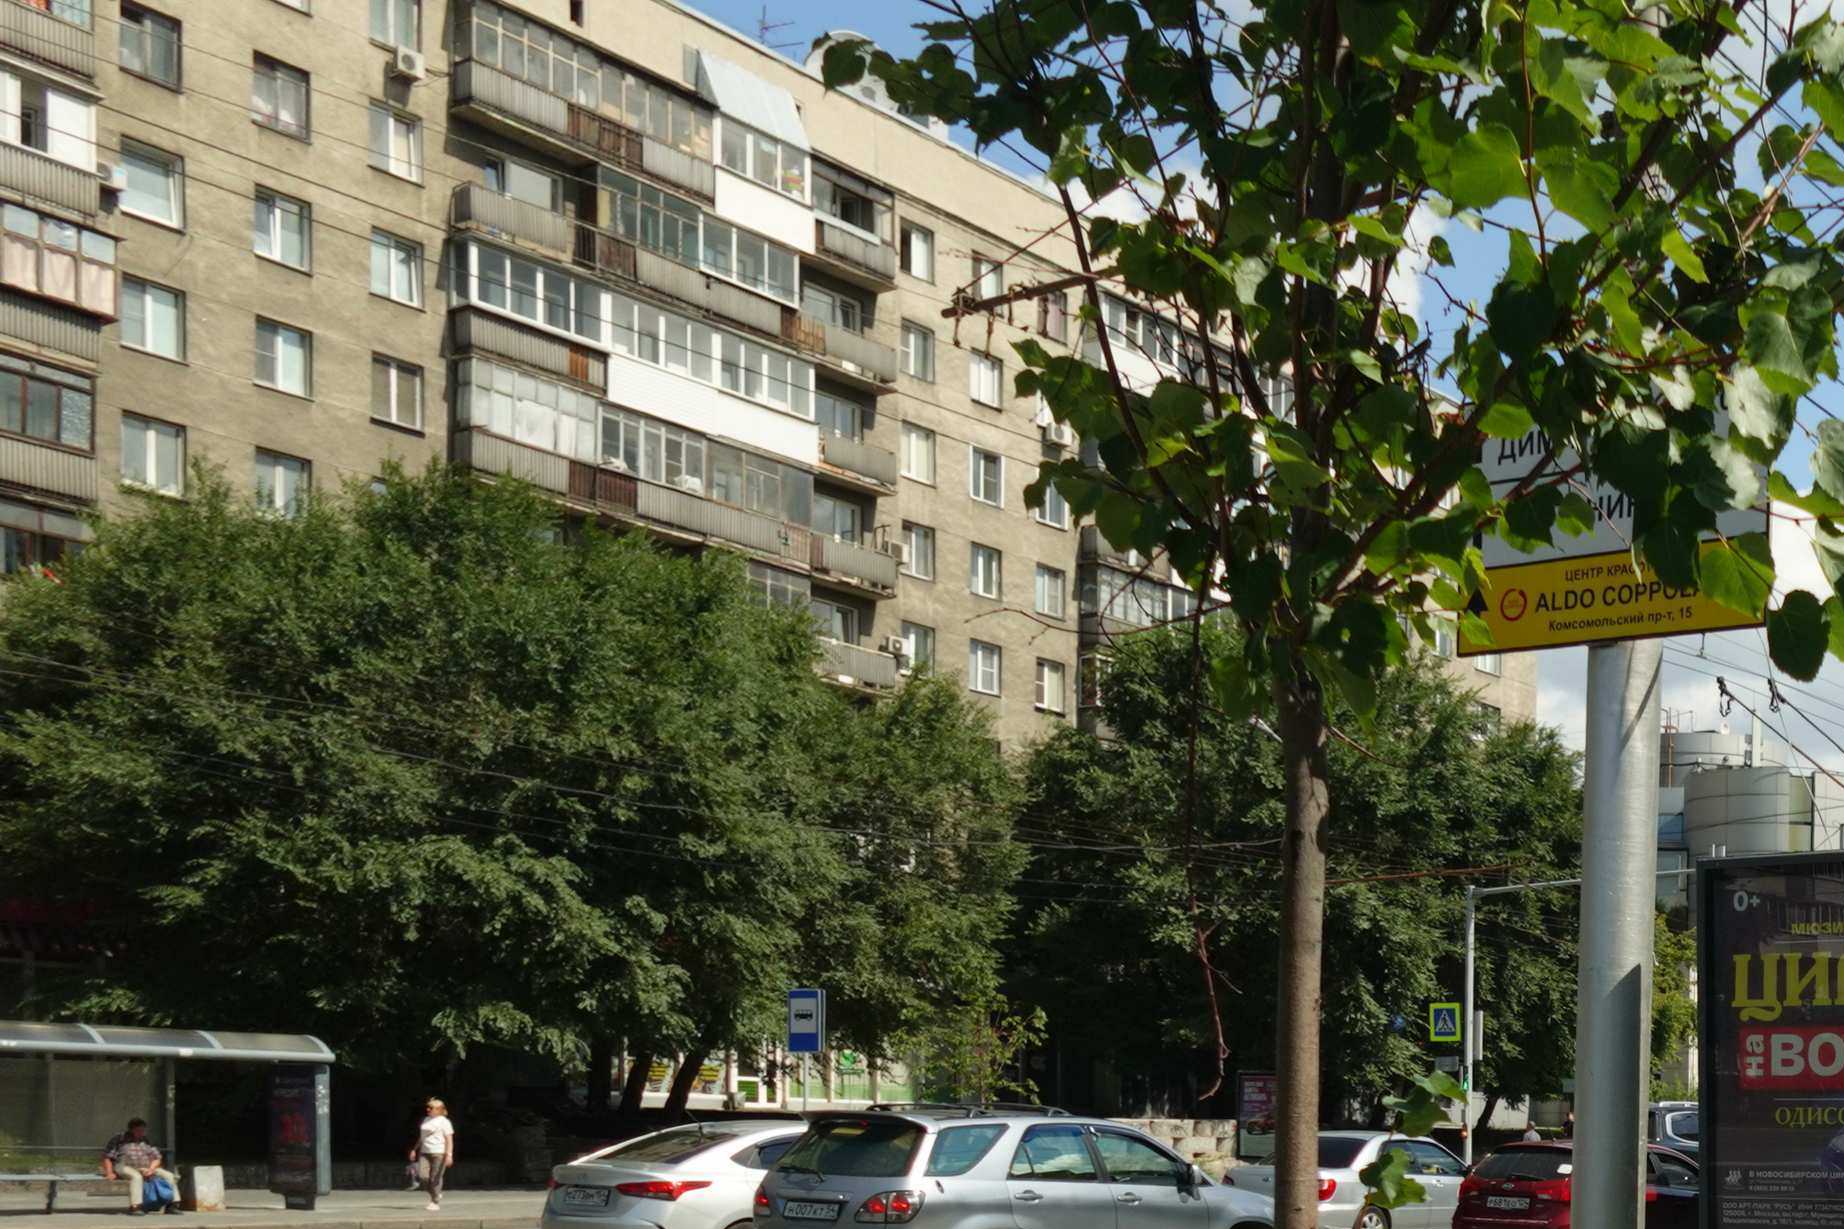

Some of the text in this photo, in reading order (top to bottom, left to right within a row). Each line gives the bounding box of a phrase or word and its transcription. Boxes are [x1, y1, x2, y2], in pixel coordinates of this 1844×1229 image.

[1565, 566, 1603, 582] ЦЕНТР
[1535, 588, 1596, 613] ALDO
[1550, 613, 1645, 632] Комсомольский
[1679, 606, 1693, 620] 15
[1733, 890, 1760, 912] 0+
[1744, 1034, 1765, 1077] на
